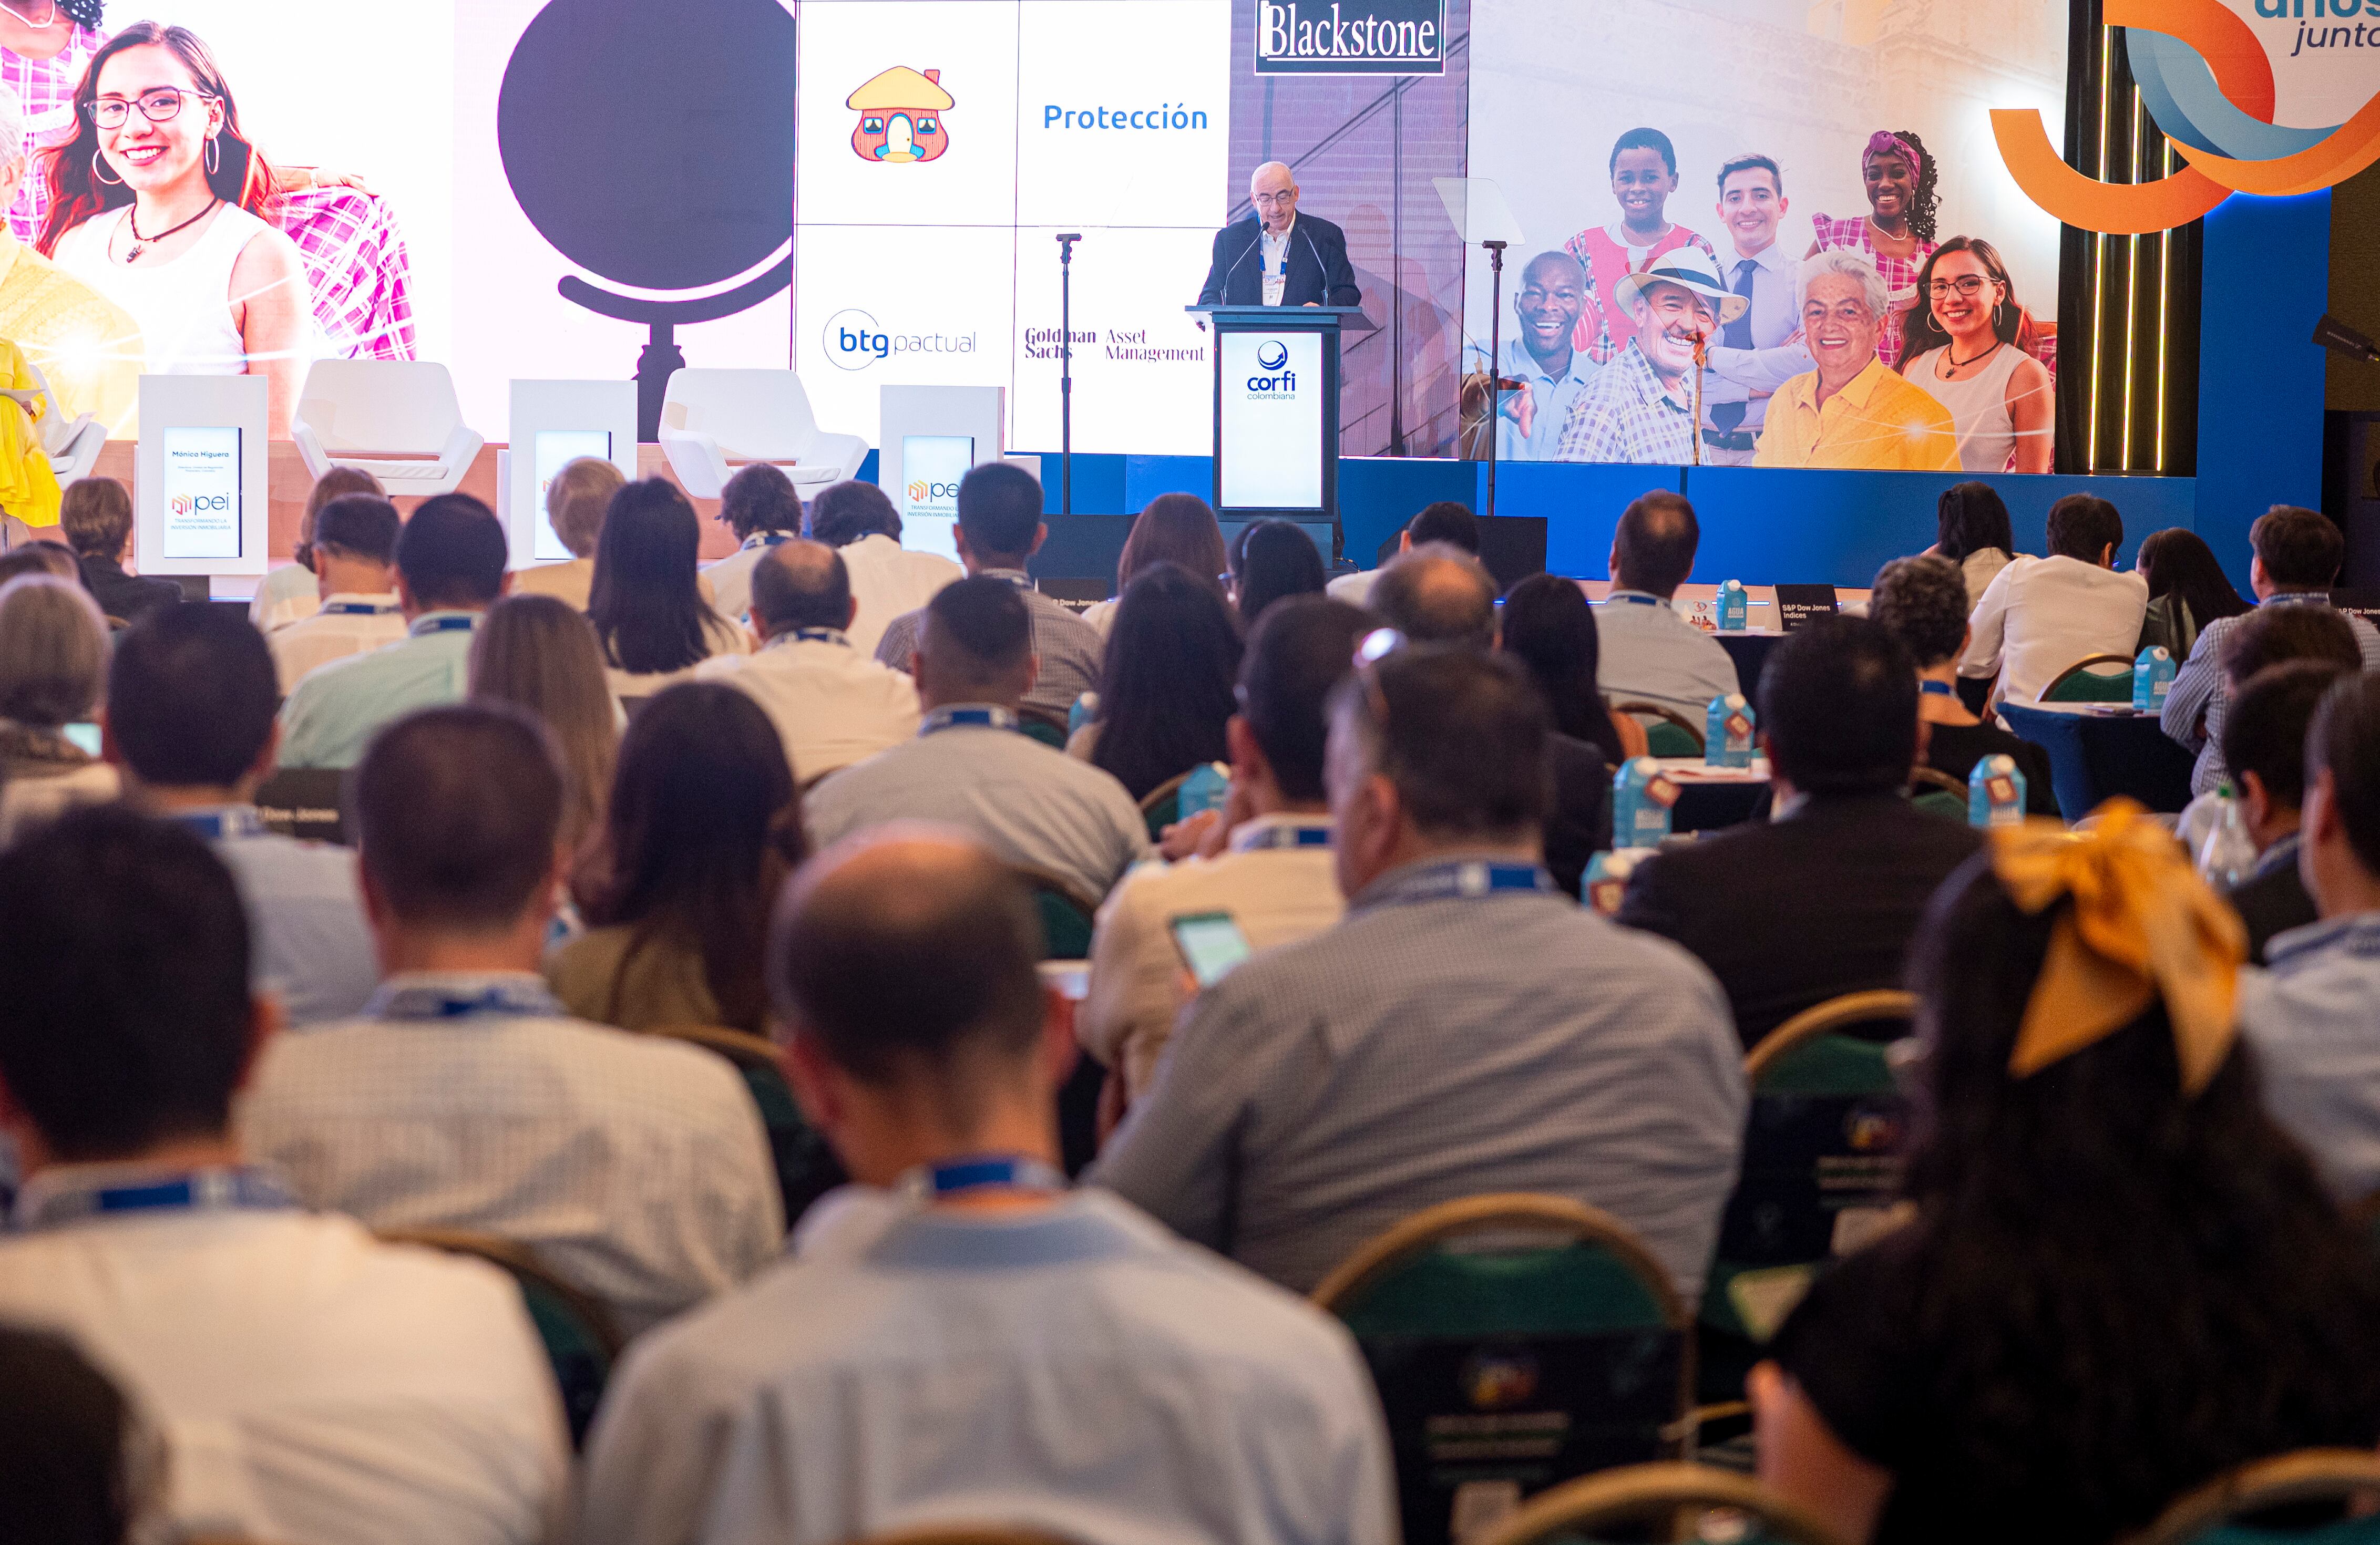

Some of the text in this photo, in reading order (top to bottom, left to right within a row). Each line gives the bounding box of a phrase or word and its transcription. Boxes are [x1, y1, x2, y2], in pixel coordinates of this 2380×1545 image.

[1260, 1, 1435, 56] Blackstone
[1044, 102, 1207, 129] Protección
[840, 327, 976, 358] btg pactual
[1106, 329, 1146, 344] Asset
[1106, 345, 1206, 364] Management
[1247, 370, 1296, 391] corfi
[930, 482, 959, 502] pe
[194, 492, 229, 516] pei
[1728, 607, 1744, 616] AGUA
